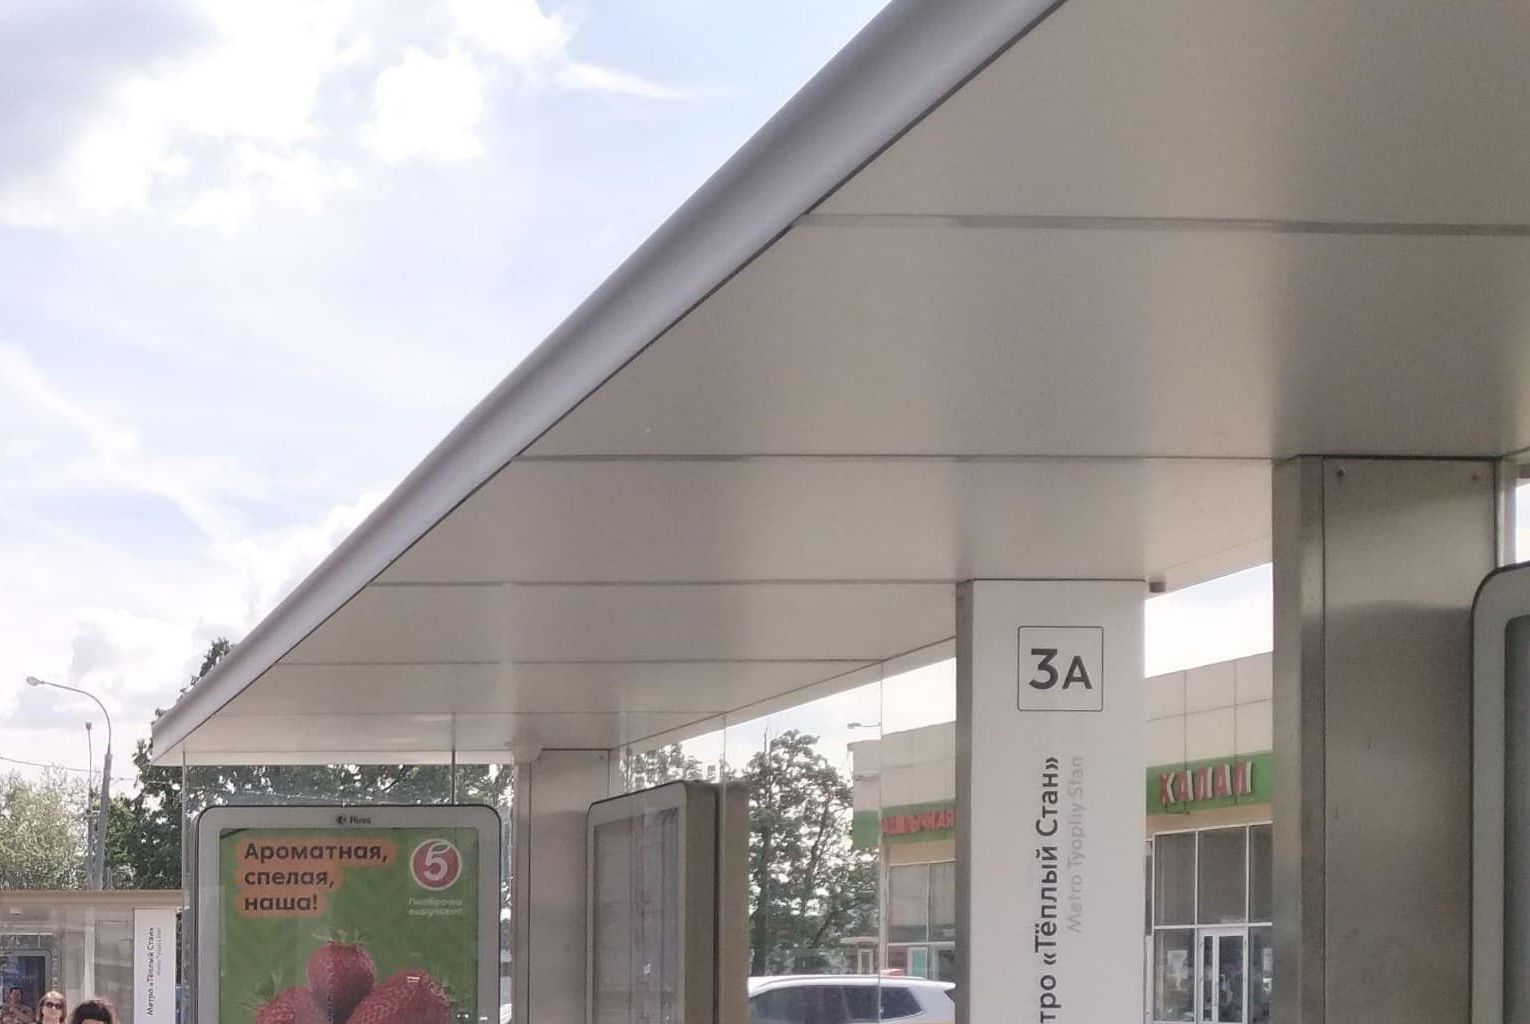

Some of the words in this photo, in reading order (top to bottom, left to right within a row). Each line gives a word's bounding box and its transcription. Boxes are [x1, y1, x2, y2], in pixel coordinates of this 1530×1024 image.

[1035, 756, 1058, 837] Стан»
[1067, 756, 1084, 802] Stan
[1158, 761, 1252, 806] ХАЛАЛ
[244, 842, 388, 863] Ароматная,
[423, 841, 451, 881] 5
[244, 870, 335, 888] спелая,
[244, 893, 318, 911] наша!
[1034, 845, 1058, 966] «Тёплый
[1067, 875, 1084, 934] Metro
